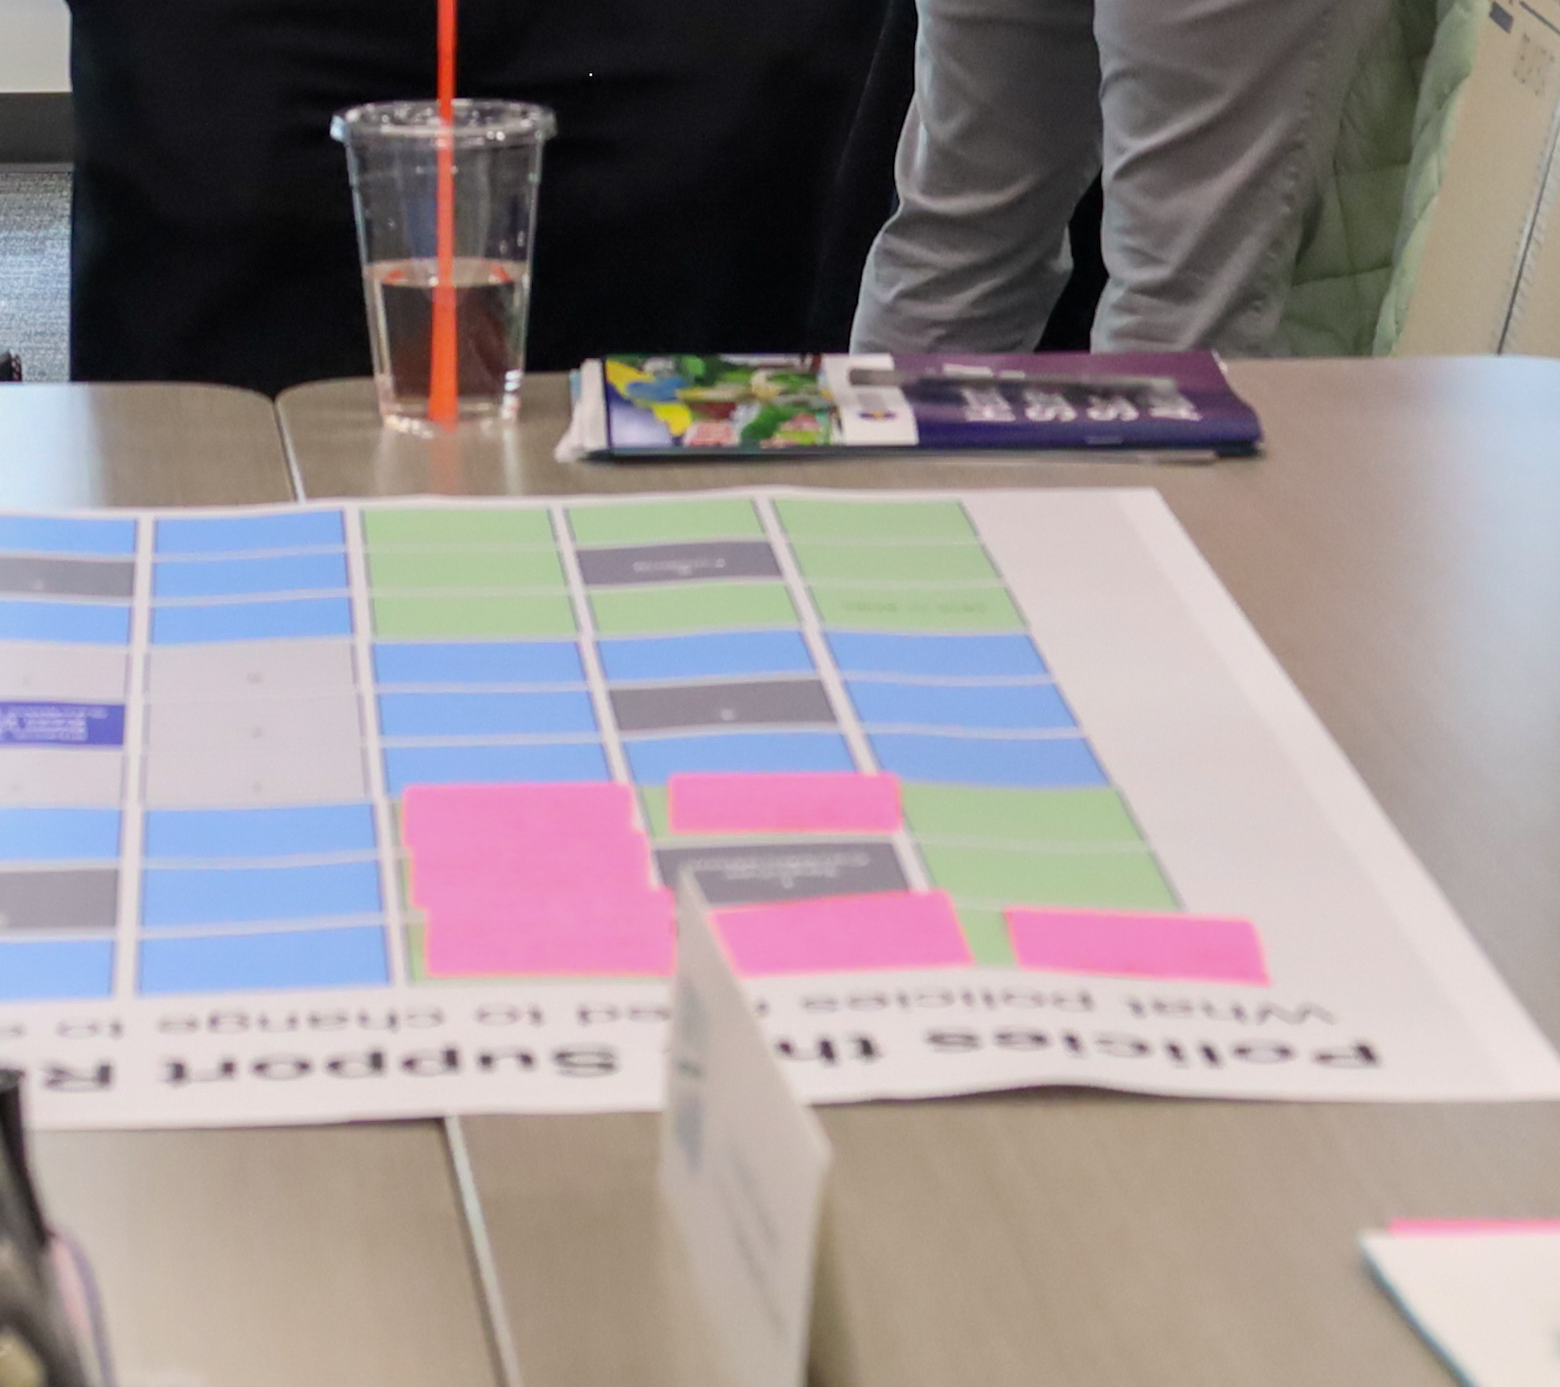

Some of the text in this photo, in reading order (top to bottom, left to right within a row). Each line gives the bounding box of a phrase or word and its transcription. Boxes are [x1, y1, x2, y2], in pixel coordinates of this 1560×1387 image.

[469, 1002, 544, 1031] to
[795, 984, 1094, 1018] policies
[1121, 994, 1335, 1028] What
[155, 1005, 443, 1040] change
[158, 1042, 618, 1092] Support
[924, 1027, 1382, 1073] Policies
